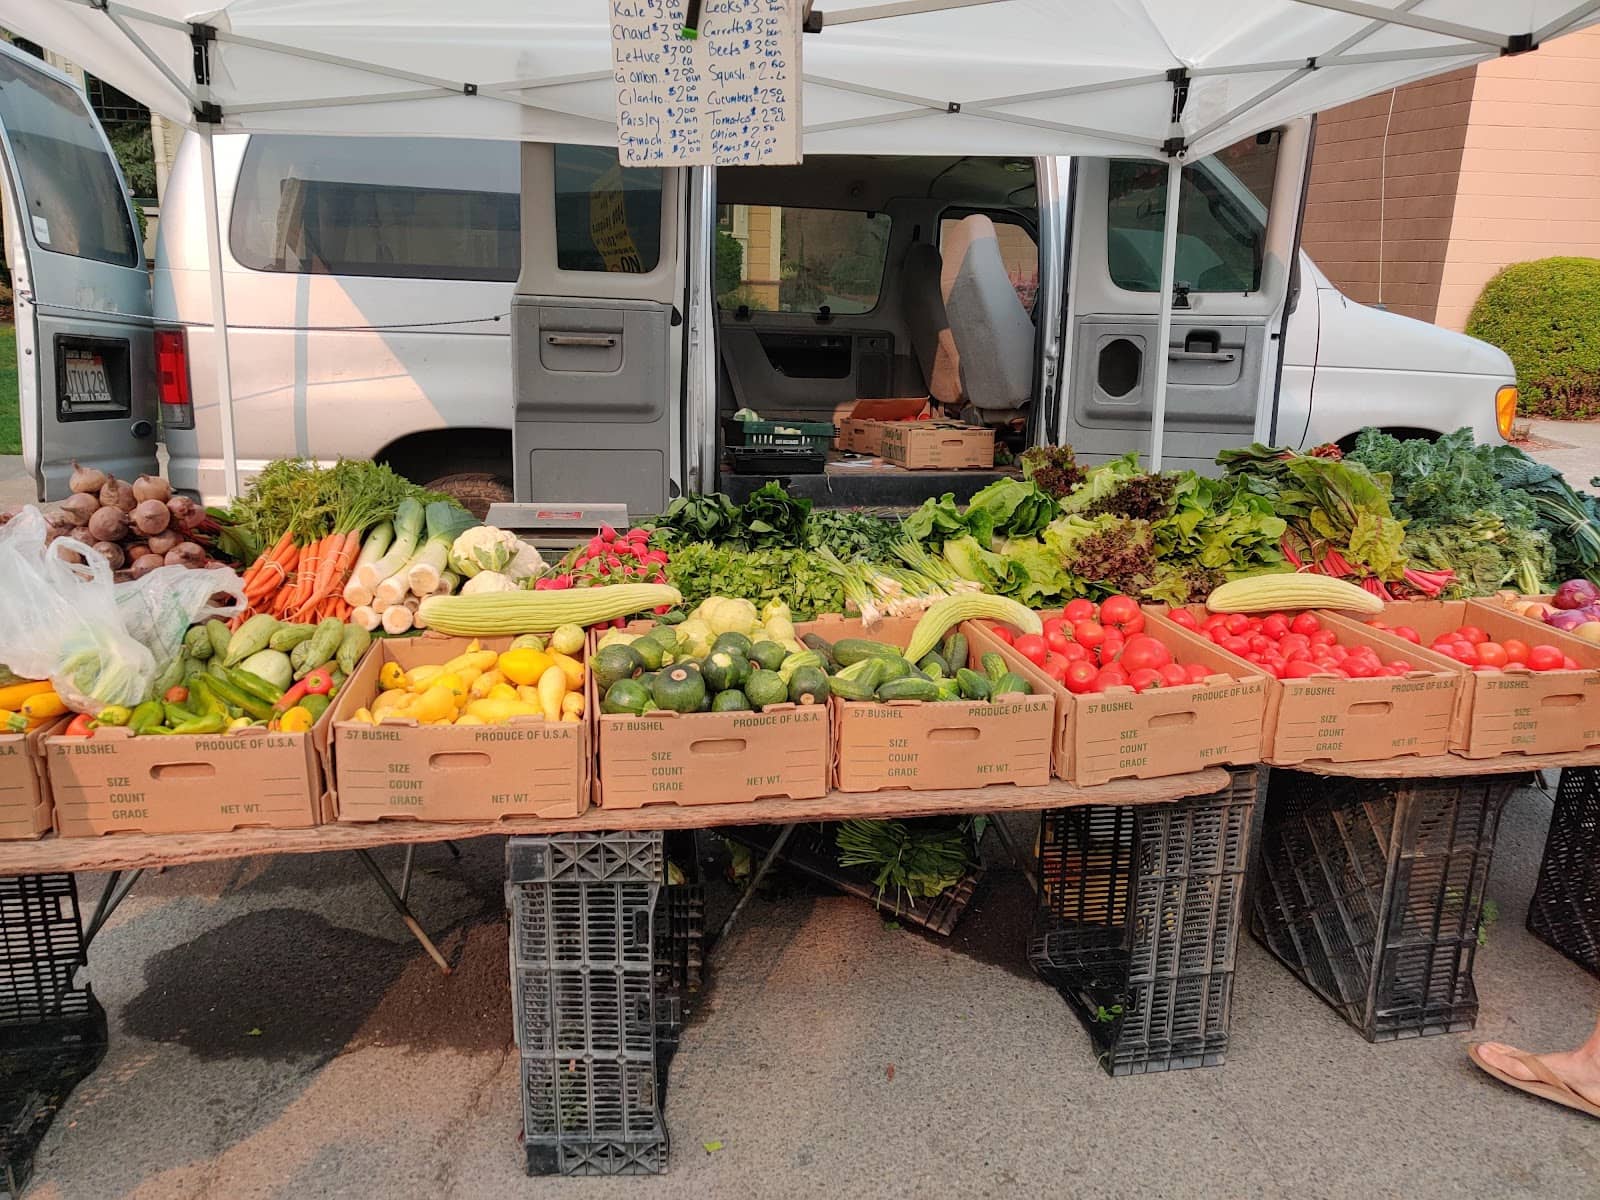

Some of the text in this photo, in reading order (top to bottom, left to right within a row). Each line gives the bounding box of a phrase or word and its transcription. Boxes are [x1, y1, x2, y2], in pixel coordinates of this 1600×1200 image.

[614, 1, 645, 17] Kale
[705, 0, 742, 14] Leeks
[613, 24, 651, 40] Chard
[708, 40, 741, 56] Beets
[616, 47, 661, 63] Lettuce
[708, 64, 745, 88] Squash
[618, 88, 663, 105] Cilantro
[707, 90, 753, 105] Cucumbers
[620, 110, 660, 134] Parsley
[712, 141, 741, 154] Beans
[627, 147, 664, 161] Radish
[715, 156, 741, 165] Corn
[1305, 687, 1336, 696] BUSHEL
[1392, 682, 1424, 693] PRODUCE
[1426, 681, 1435, 690] OF
[1192, 691, 1228, 702] PRODUCE
[1230, 688, 1240, 697] OF
[968, 706, 1010, 717] PRODUCE
[1012, 705, 1023, 714] OF
[1086, 702, 1134, 714] .57 BUSHEL
[868, 709, 903, 719] BUSHEL
[1321, 715, 1337, 723] SIZE
[610, 721, 664, 731] .57 BUSHEL
[733, 716, 777, 728] PRODUCE
[780, 715, 792, 724] OF
[362, 730, 401, 741] BUSHEL
[475, 731, 524, 742] PRODUCE
[526, 730, 540, 740] OF
[1120, 730, 1138, 740] SIZE
[1319, 728, 1344, 738] COUNT
[195, 739, 247, 751] PRODUCE
[250, 738, 264, 750] OF
[889, 738, 908, 748] SIZE
[1316, 743, 1343, 751] GRADE
[1392, 738, 1405, 746] NET
[56, 744, 118, 755] .57 BUSHEL
[1120, 743, 1148, 754] COUNT
[1200, 748, 1214, 758] NET
[651, 752, 672, 761] SIZE
[888, 753, 919, 762] COUNT
[389, 763, 410, 773] SIZE
[1119, 757, 1148, 768] GRADE
[651, 766, 684, 777] COUNT
[888, 767, 918, 777] GRADE
[976, 764, 994, 774] NET
[107, 776, 130, 787] SIZE
[389, 780, 424, 790] COUNT
[652, 781, 683, 791] GRADE
[746, 775, 764, 786] NET
[109, 792, 145, 804] COUNT
[389, 796, 424, 806] GRADE
[491, 794, 511, 804] NET
[112, 808, 149, 819] GRADE
[220, 804, 241, 815] NET
